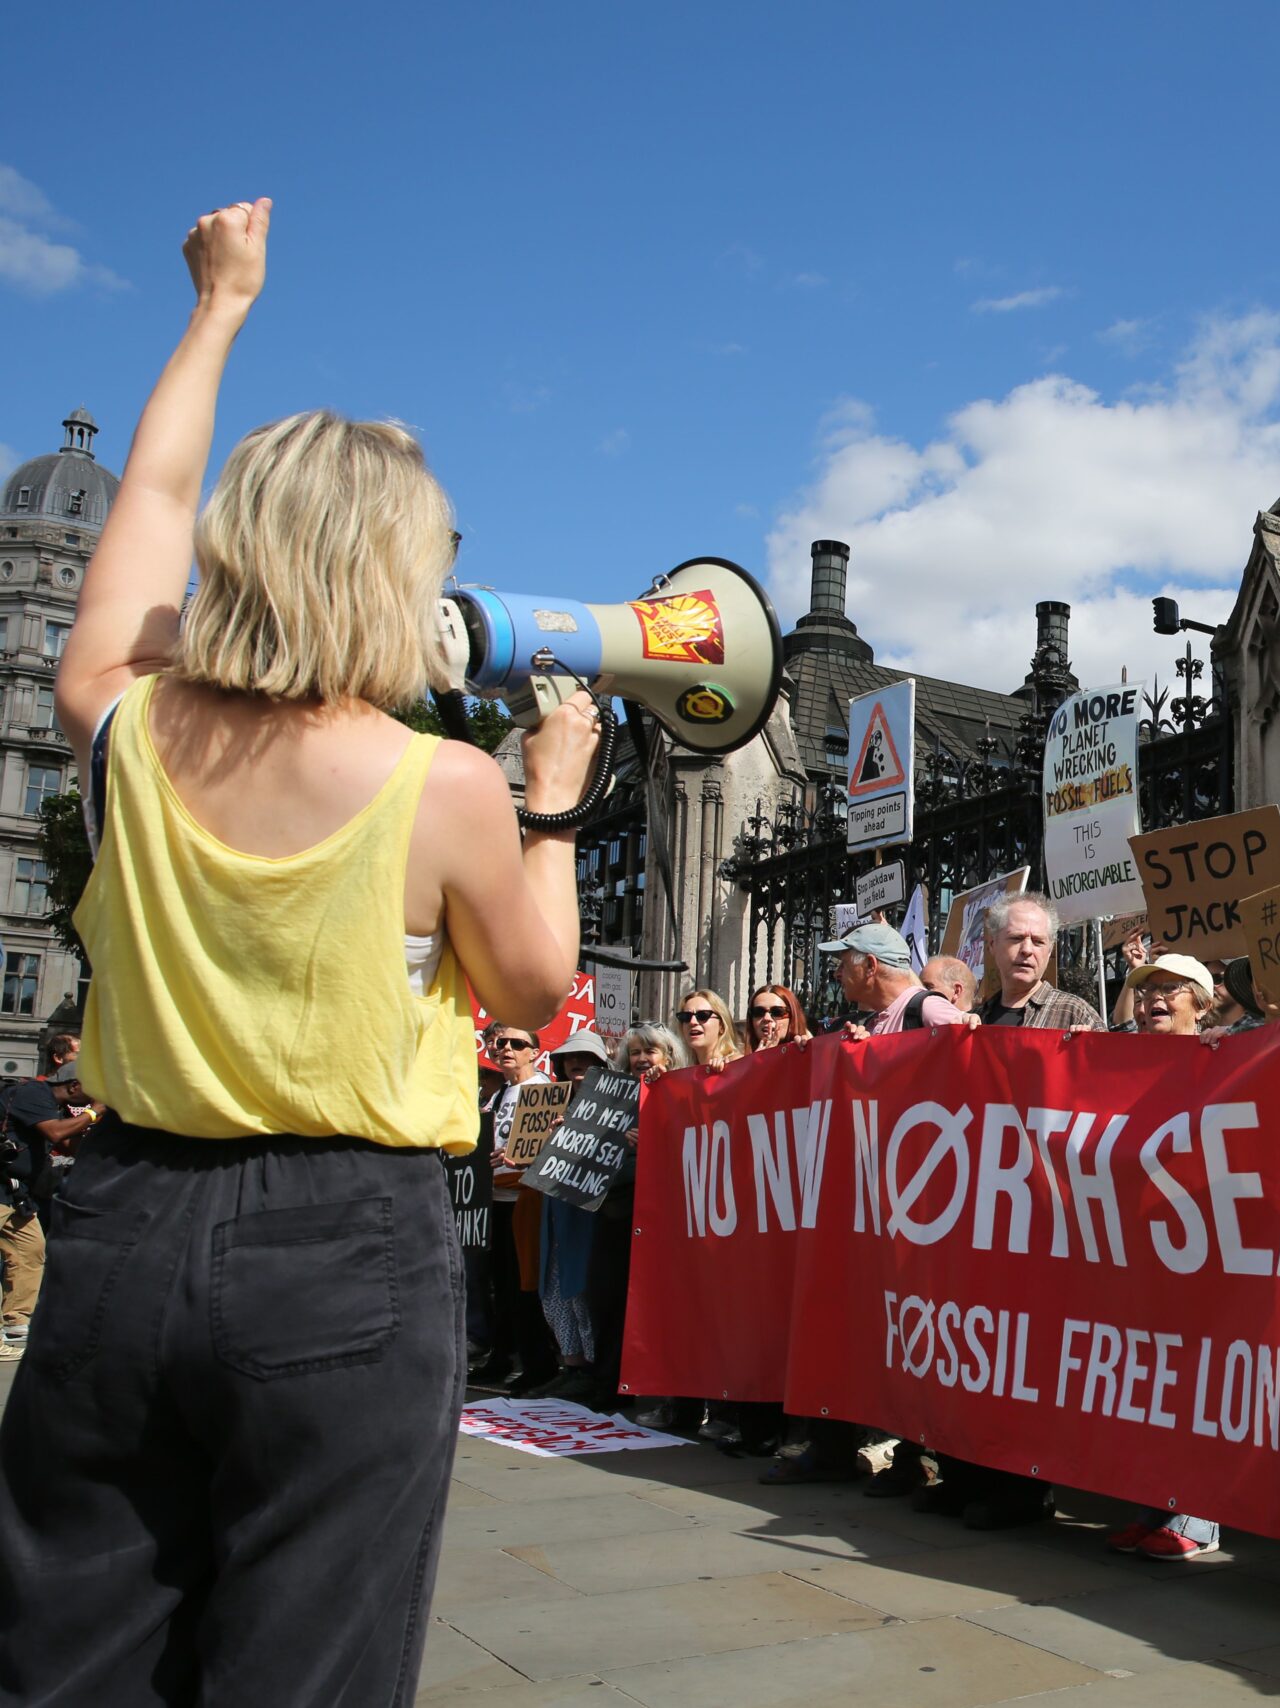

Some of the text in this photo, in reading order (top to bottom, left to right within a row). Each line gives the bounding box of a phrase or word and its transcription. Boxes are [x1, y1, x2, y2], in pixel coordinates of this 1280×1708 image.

[1048, 690, 1137, 742] NO MORE
[1063, 722, 1109, 757] PLANET
[1054, 743, 1116, 783] WRECKING
[1046, 768, 1132, 815] FOSSIL FUELS
[850, 803, 901, 823] Tipping points
[864, 820, 885, 833] ahead
[1073, 821, 1102, 844] THIS
[1085, 845, 1096, 859] IS
[1144, 830, 1267, 889] STOP
[857, 872, 895, 895] Stop Jackdaw
[872, 888, 885, 900] field
[1052, 860, 1136, 900] UNFORGIVABLE
[844, 907, 855, 915] NO
[600, 993, 626, 1010] NO to
[519, 1084, 569, 1107] NO NEW
[594, 1074, 640, 1101] MIATTA
[572, 1098, 634, 1132] NO NEW
[551, 1126, 600, 1158] NORTH
[454, 1166, 474, 1204] TO
[539, 1155, 609, 1196] DRILLING
[682, 1119, 737, 1237] NO
[1055, 1318, 1183, 1430] FREE
